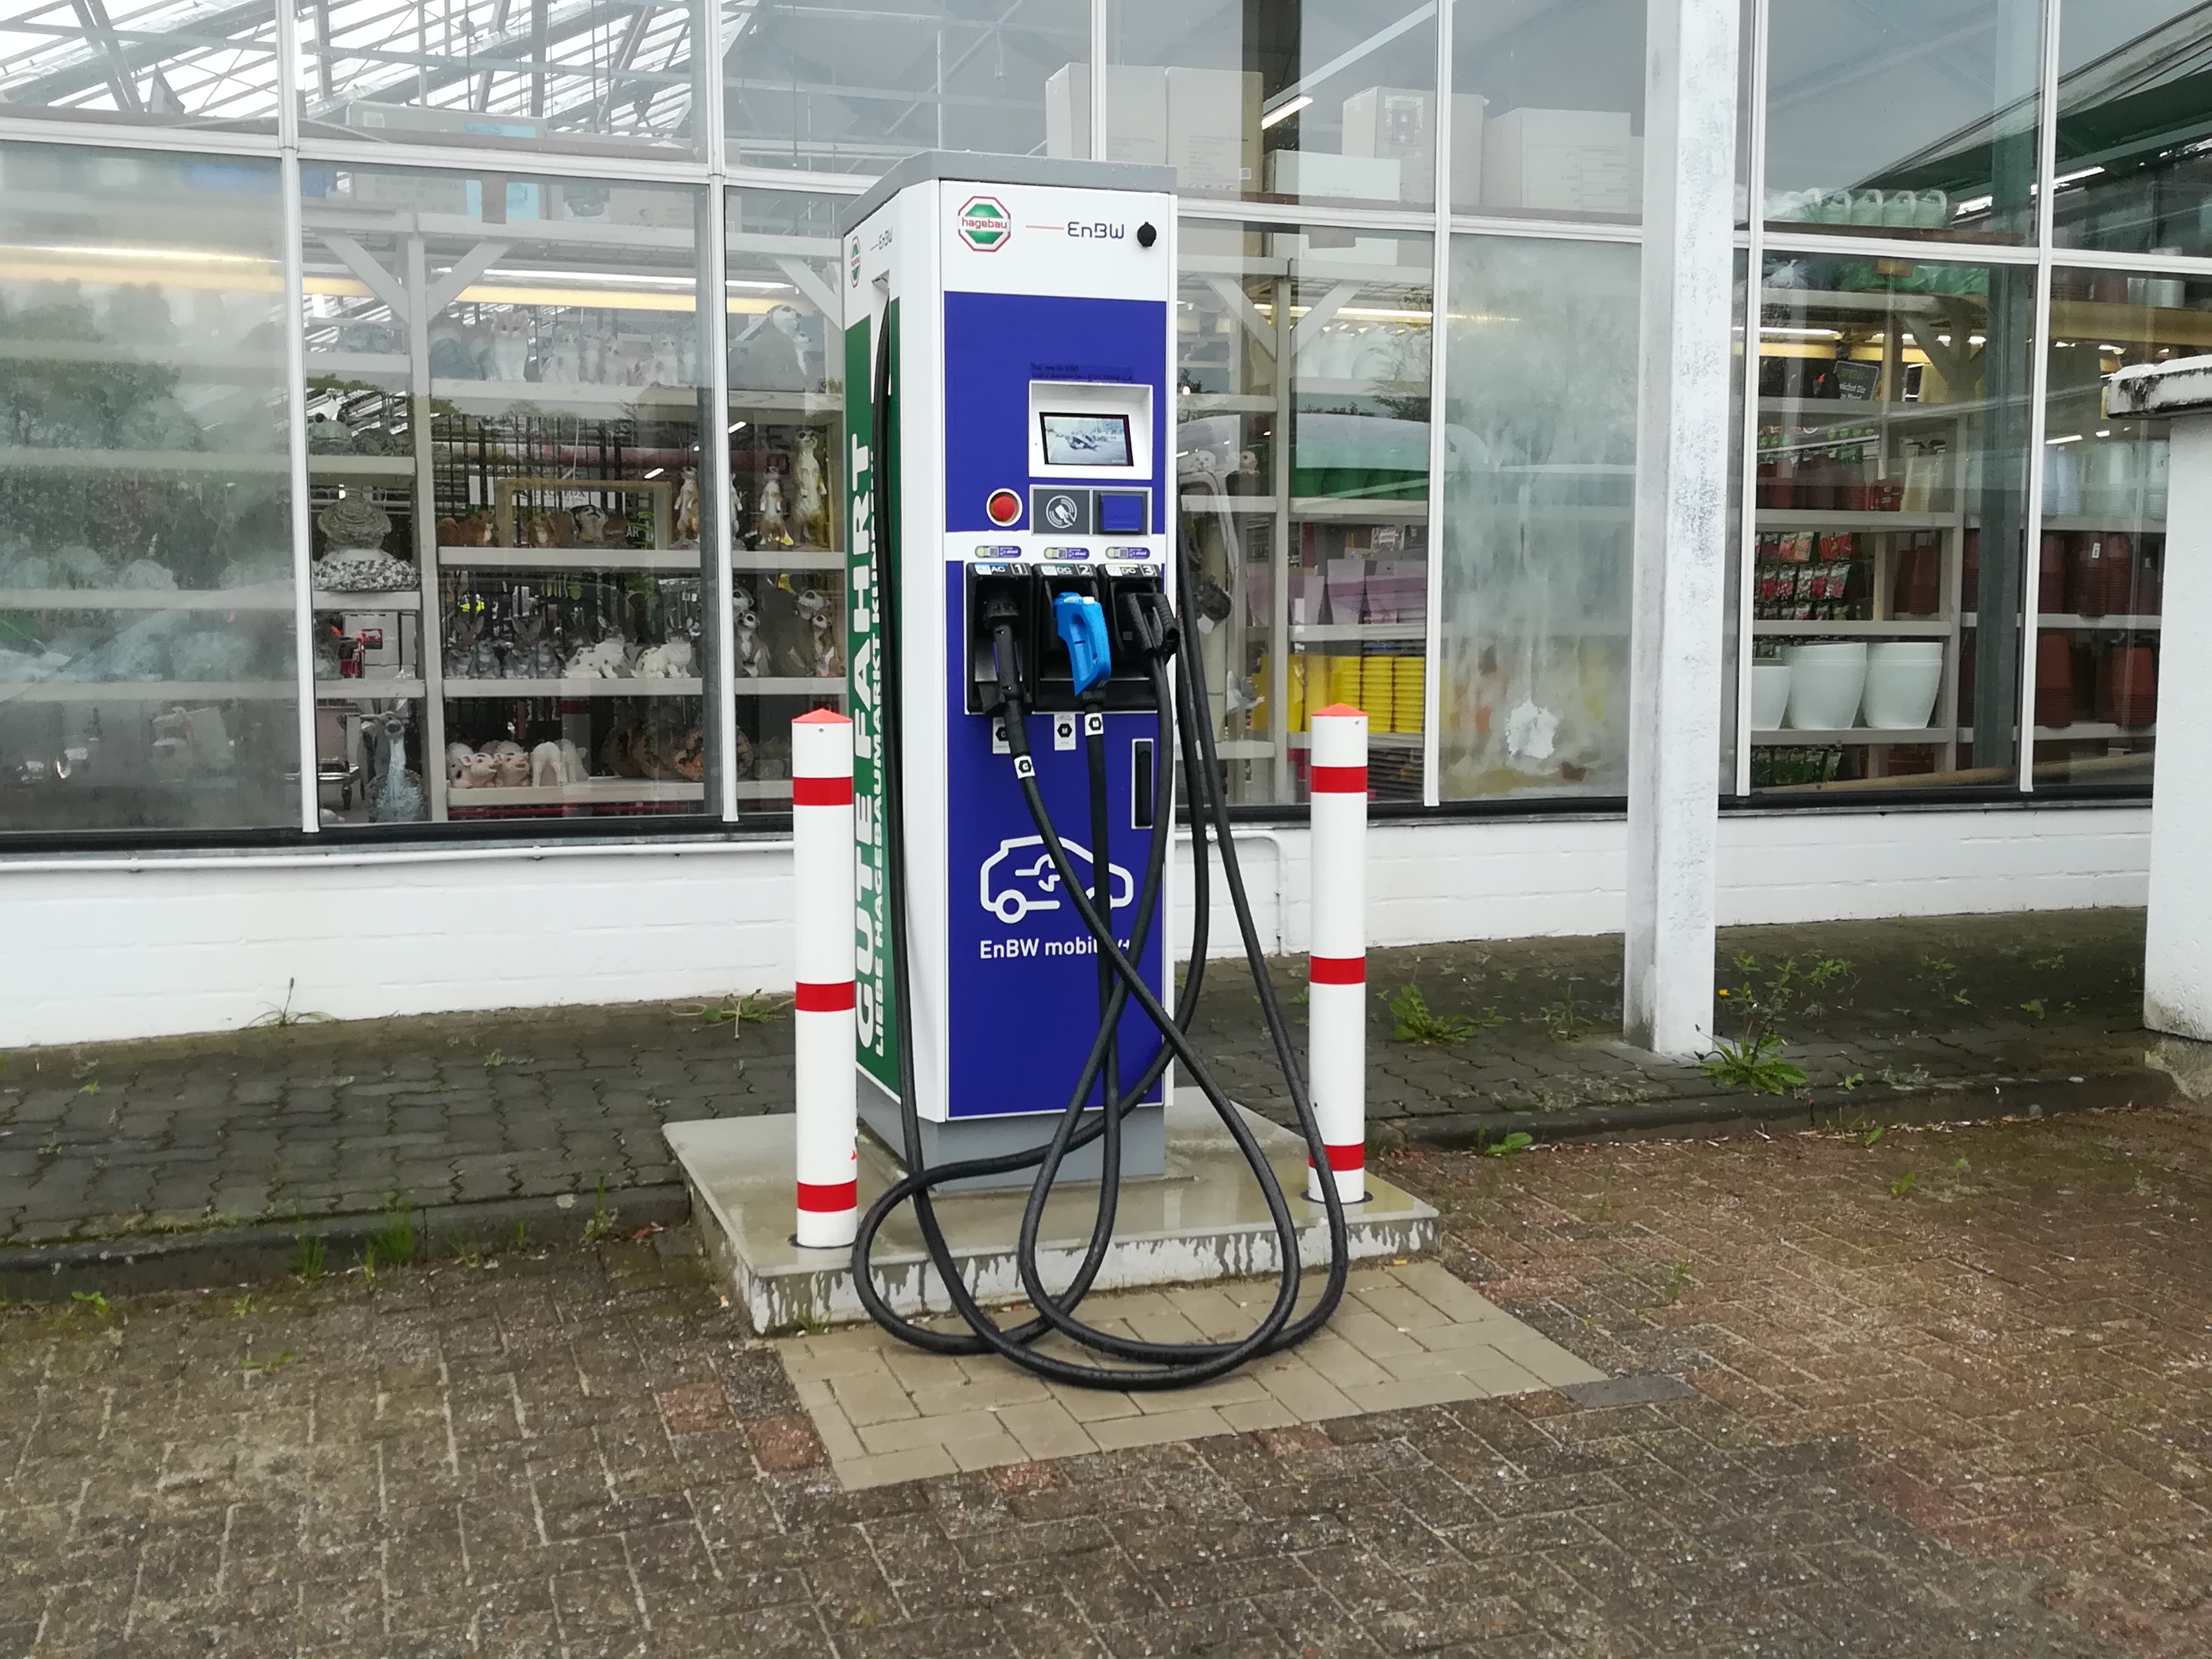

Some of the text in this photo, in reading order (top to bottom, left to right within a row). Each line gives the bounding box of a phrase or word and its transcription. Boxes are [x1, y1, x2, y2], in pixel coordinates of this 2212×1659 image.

[962, 217, 1007, 229] hagebau
[1068, 221, 1124, 239] EnBW
[1015, 564, 1023, 575] 1
[1079, 565, 1091, 575] 2
[1143, 565, 1154, 575] 3
[851, 433, 874, 1048] GUTE FAHRT
[872, 633, 883, 948] HAGEBAUMARKT
[980, 938, 1039, 959] EnBW
[875, 955, 884, 1057] LIEBE
